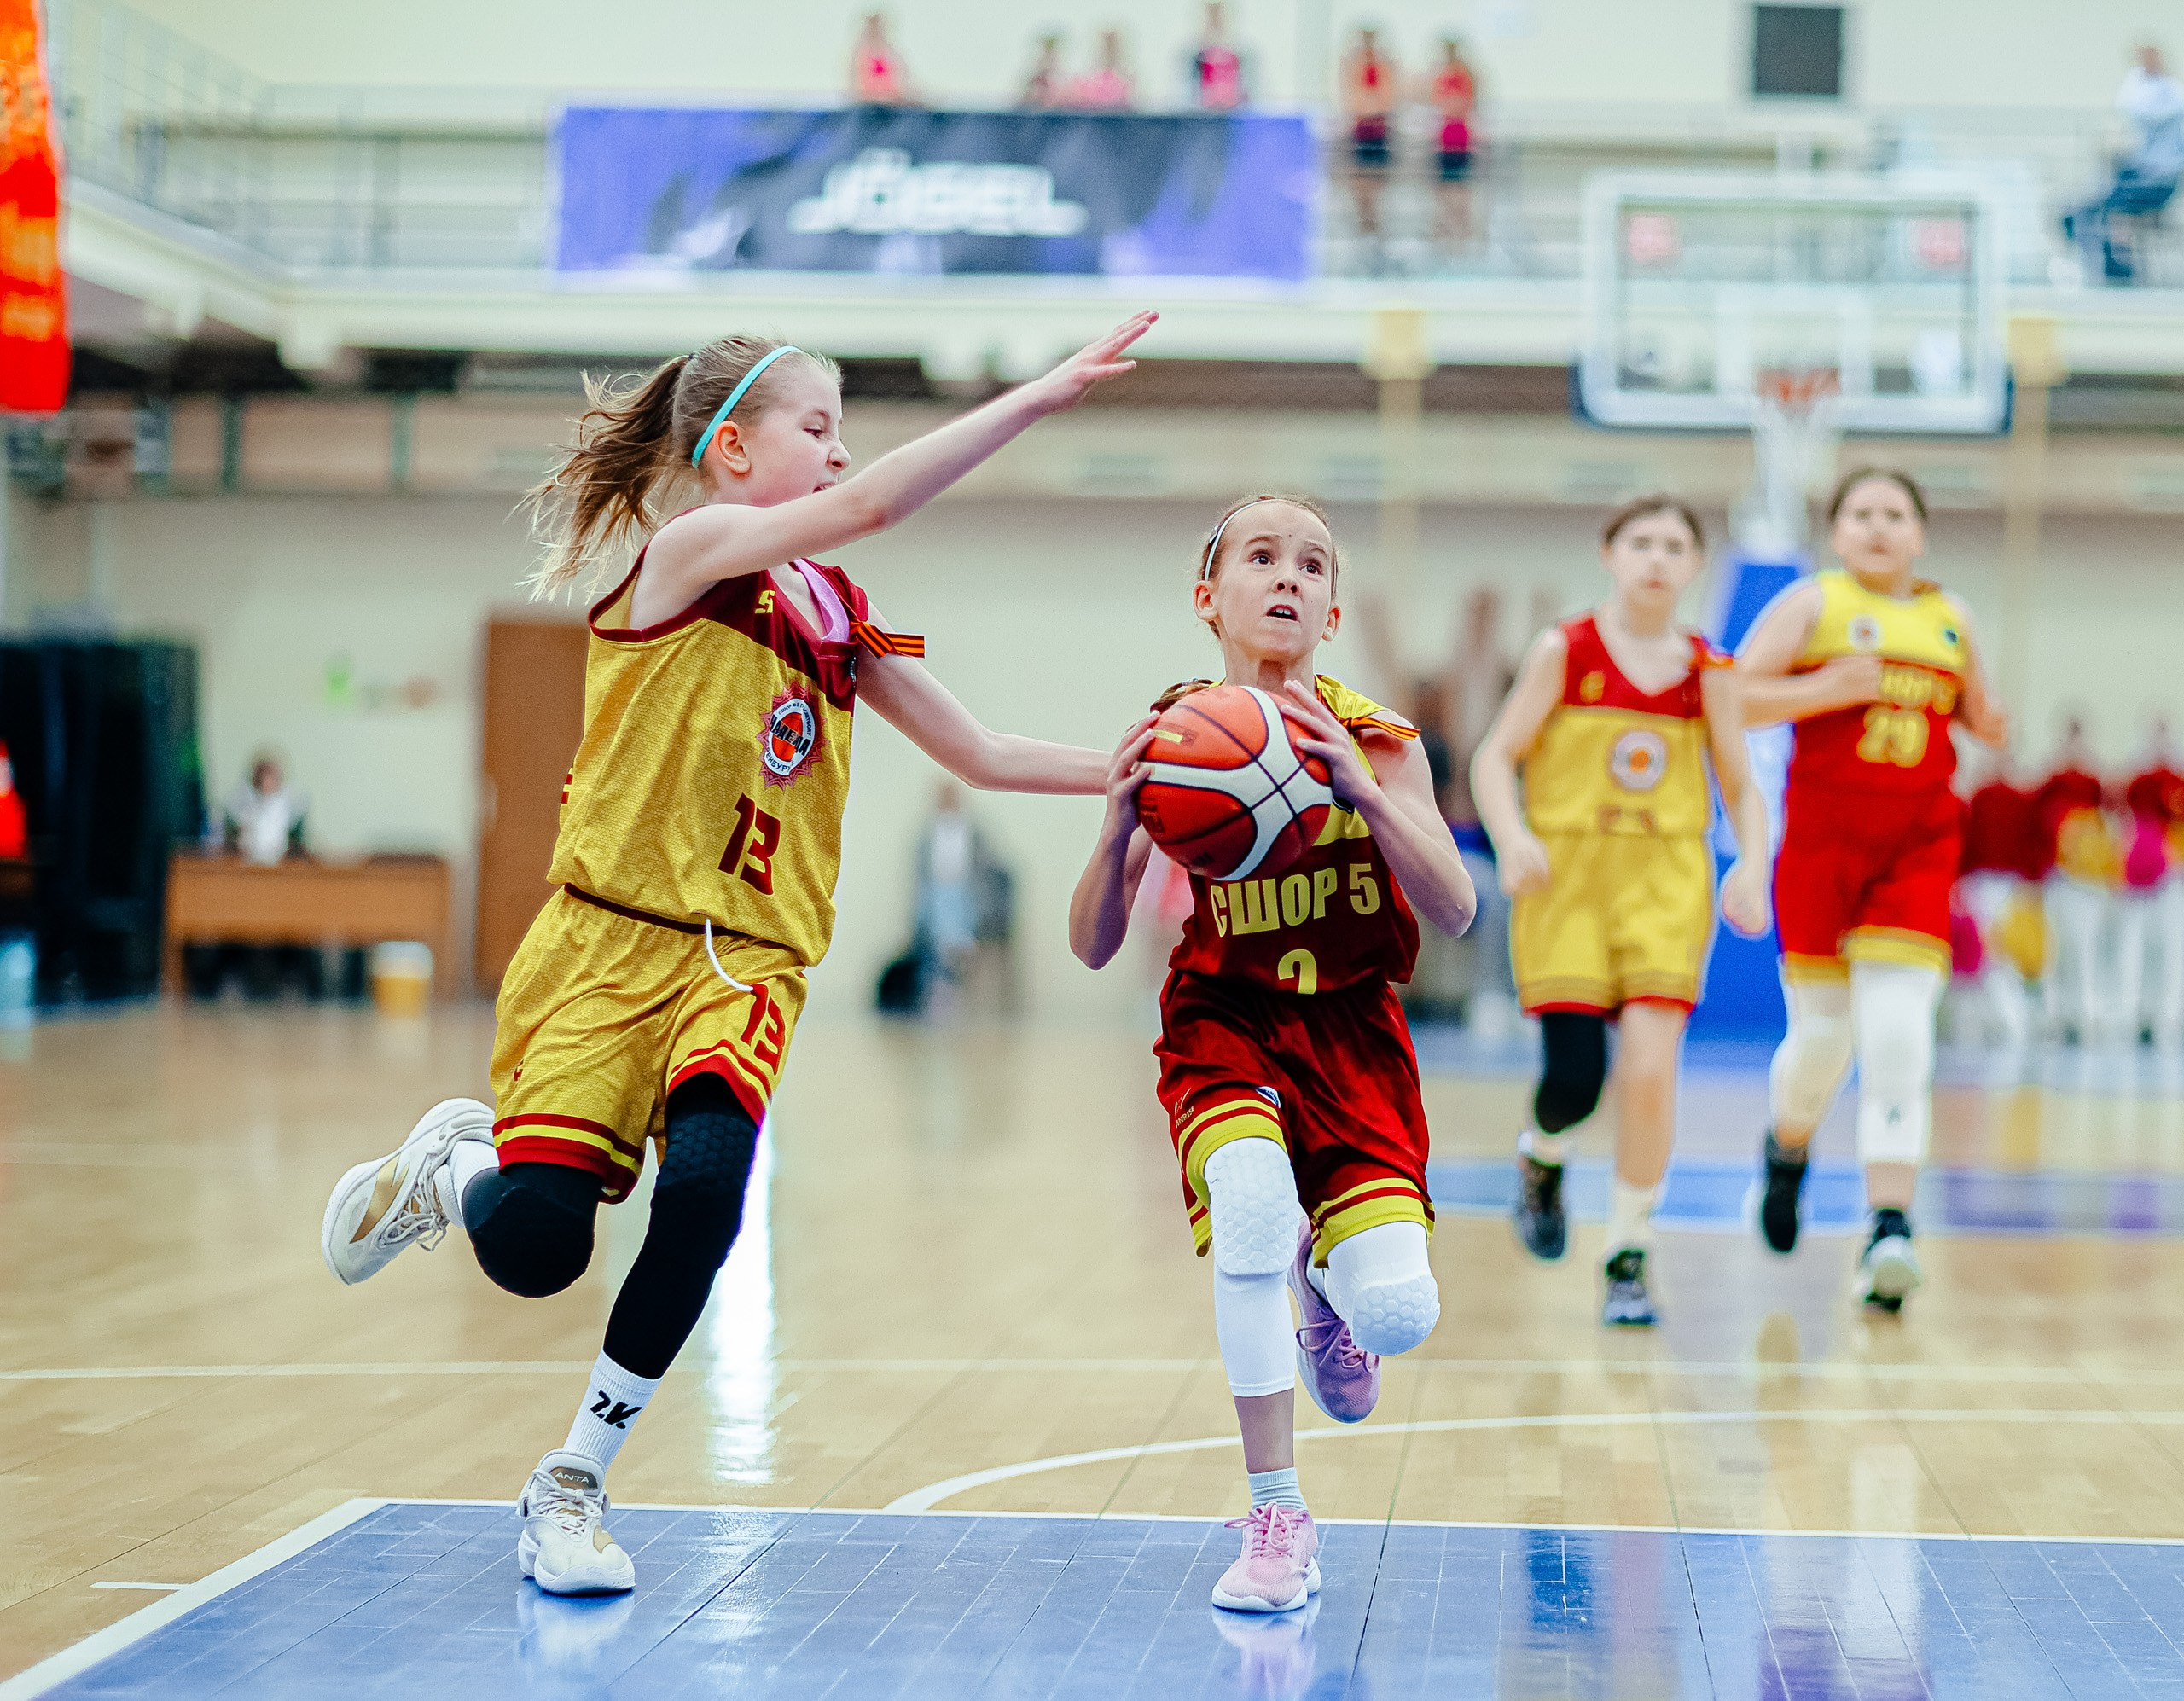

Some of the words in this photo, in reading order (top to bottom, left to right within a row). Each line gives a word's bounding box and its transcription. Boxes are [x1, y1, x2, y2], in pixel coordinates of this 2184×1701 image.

[717, 792, 781, 896] 13
[1210, 867, 1338, 938] СШОР
[1349, 862, 1380, 915] 5
[741, 984, 786, 1076] 13
[555, 1472, 590, 1483] ANTA
